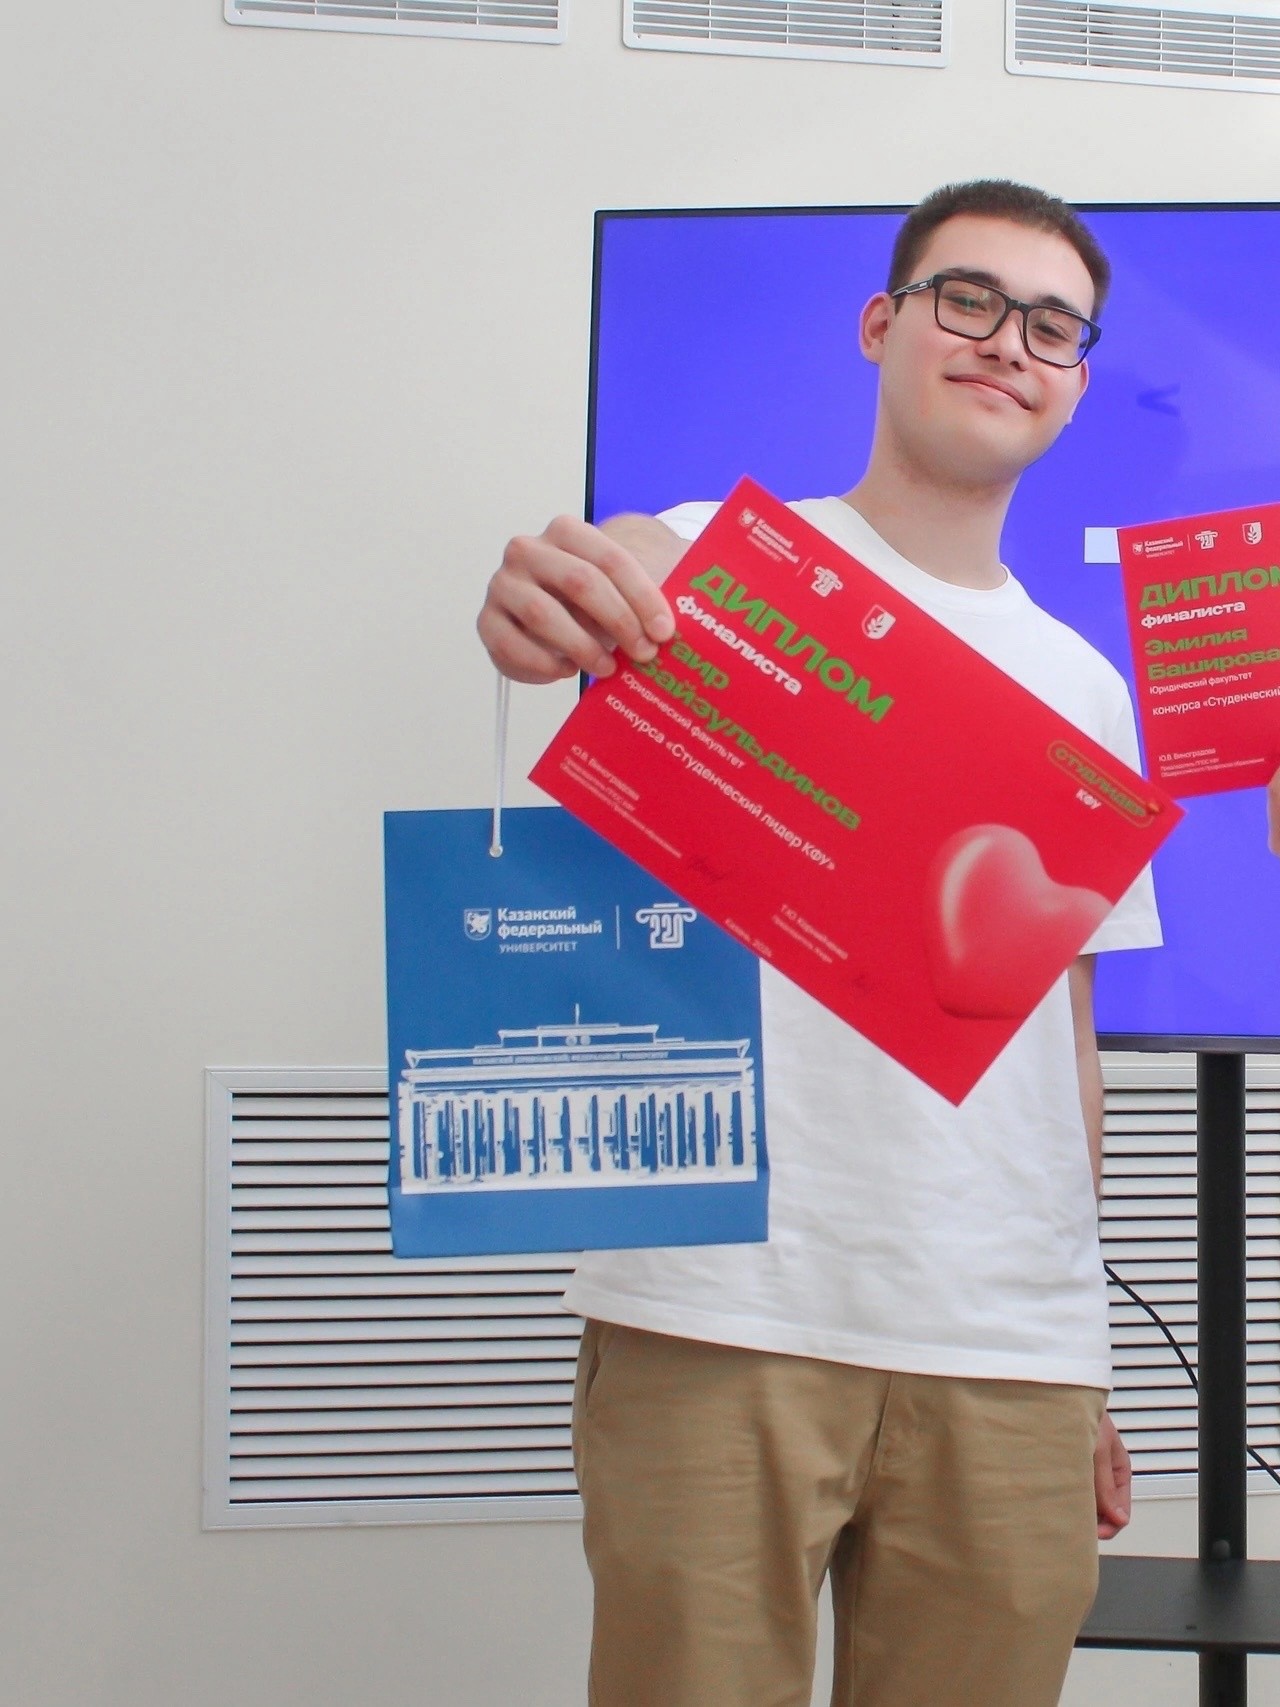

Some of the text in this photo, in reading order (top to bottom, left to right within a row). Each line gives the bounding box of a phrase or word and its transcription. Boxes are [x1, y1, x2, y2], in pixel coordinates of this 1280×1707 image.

[1141, 601, 1246, 628] финалиста
[676, 596, 802, 695] финалиста
[689, 564, 895, 723] ДИПЛОМ
[1145, 628, 1247, 656] Эмилия
[670, 630, 731, 690] аир
[1150, 671, 1253, 695] Юридический факультет
[621, 671, 746, 770] Юридический факультет
[1152, 700, 1201, 716] конкурса
[605, 694, 666, 744] конкурса
[666, 741, 763, 819] «Студенческий
[761, 812, 802, 849] лидер
[801, 840, 836, 871] КФУ»
[497, 906, 577, 922] Казанский
[497, 920, 603, 939] федеральный
[499, 941, 578, 954] УНИВЕРСИТЕТ
